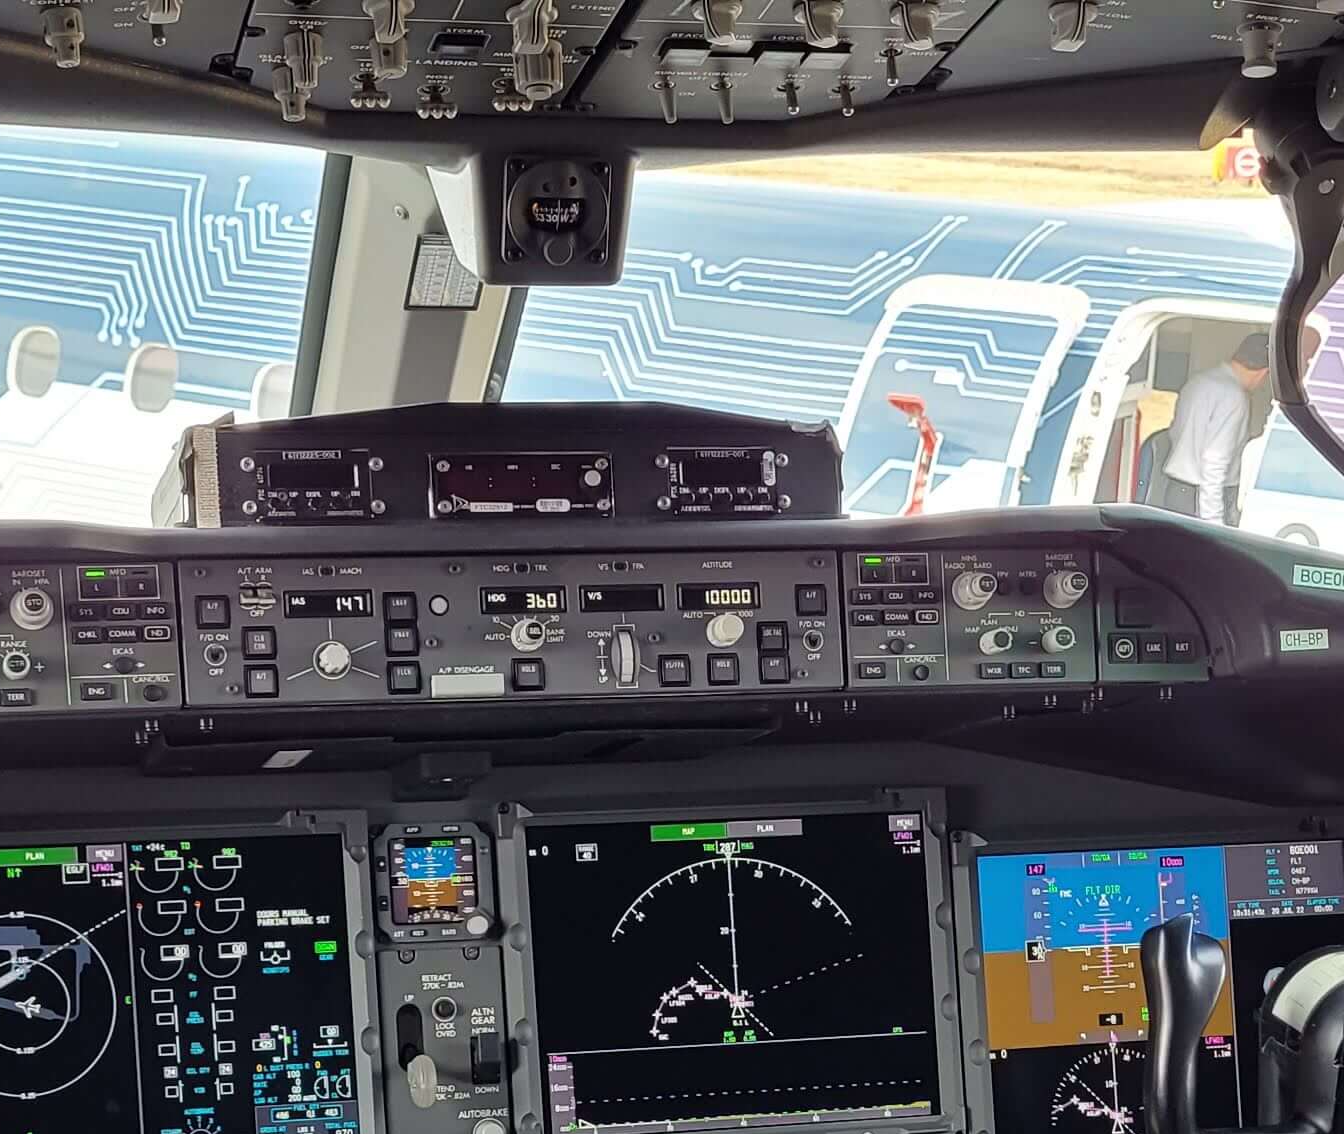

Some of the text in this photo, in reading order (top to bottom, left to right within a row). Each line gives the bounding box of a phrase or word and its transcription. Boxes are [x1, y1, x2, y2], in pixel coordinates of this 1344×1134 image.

[702, 560, 733, 569] ALTITUDE
[487, 594, 506, 602] HDG
[705, 588, 751, 605] 10000
[292, 597, 364, 612] IAS 147
[79, 608, 93, 616] SYS
[112, 607, 130, 615] CDU
[485, 633, 505, 641] AUTO
[587, 631, 611, 639] DOWN
[1285, 632, 1324, 647] CH-BP
[0, 640, 28, 648] RANGE
[88, 687, 105, 696] ENG
[719, 842, 737, 853] 287
[1289, 845, 1319, 855] BOE001
[1028, 866, 1043, 875] 147
[1085, 885, 1120, 895] FLT DIR
[421, 974, 452, 982] RETRACT
[471, 1007, 495, 1016] ALTN
[471, 1016, 495, 1025] GEAR
[475, 1086, 499, 1094] DOWN
[458, 1108, 509, 1119] AUTOBRAKE
